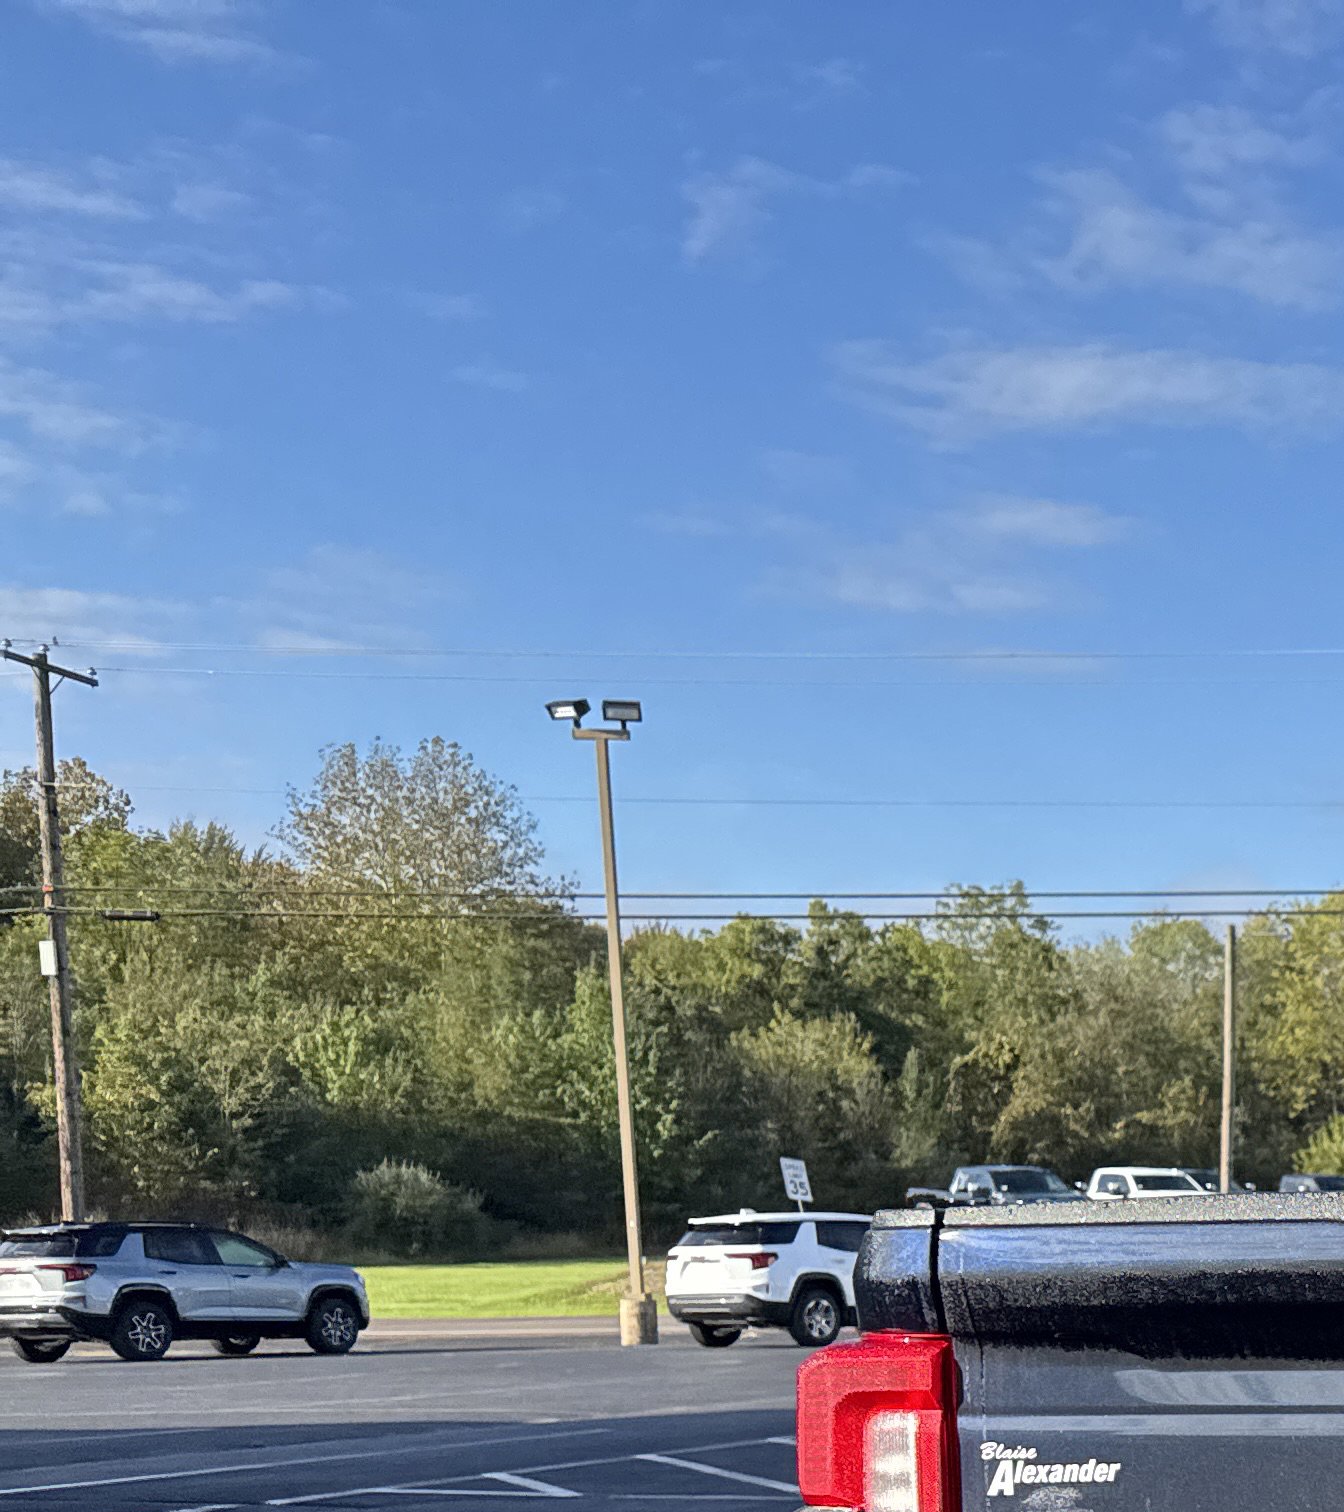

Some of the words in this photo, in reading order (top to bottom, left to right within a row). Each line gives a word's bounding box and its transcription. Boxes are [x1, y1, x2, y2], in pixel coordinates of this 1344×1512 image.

[789, 1179, 809, 1196] 35
[980, 1442, 1037, 1460] Blaise
[986, 1459, 1121, 1496] Alexander
